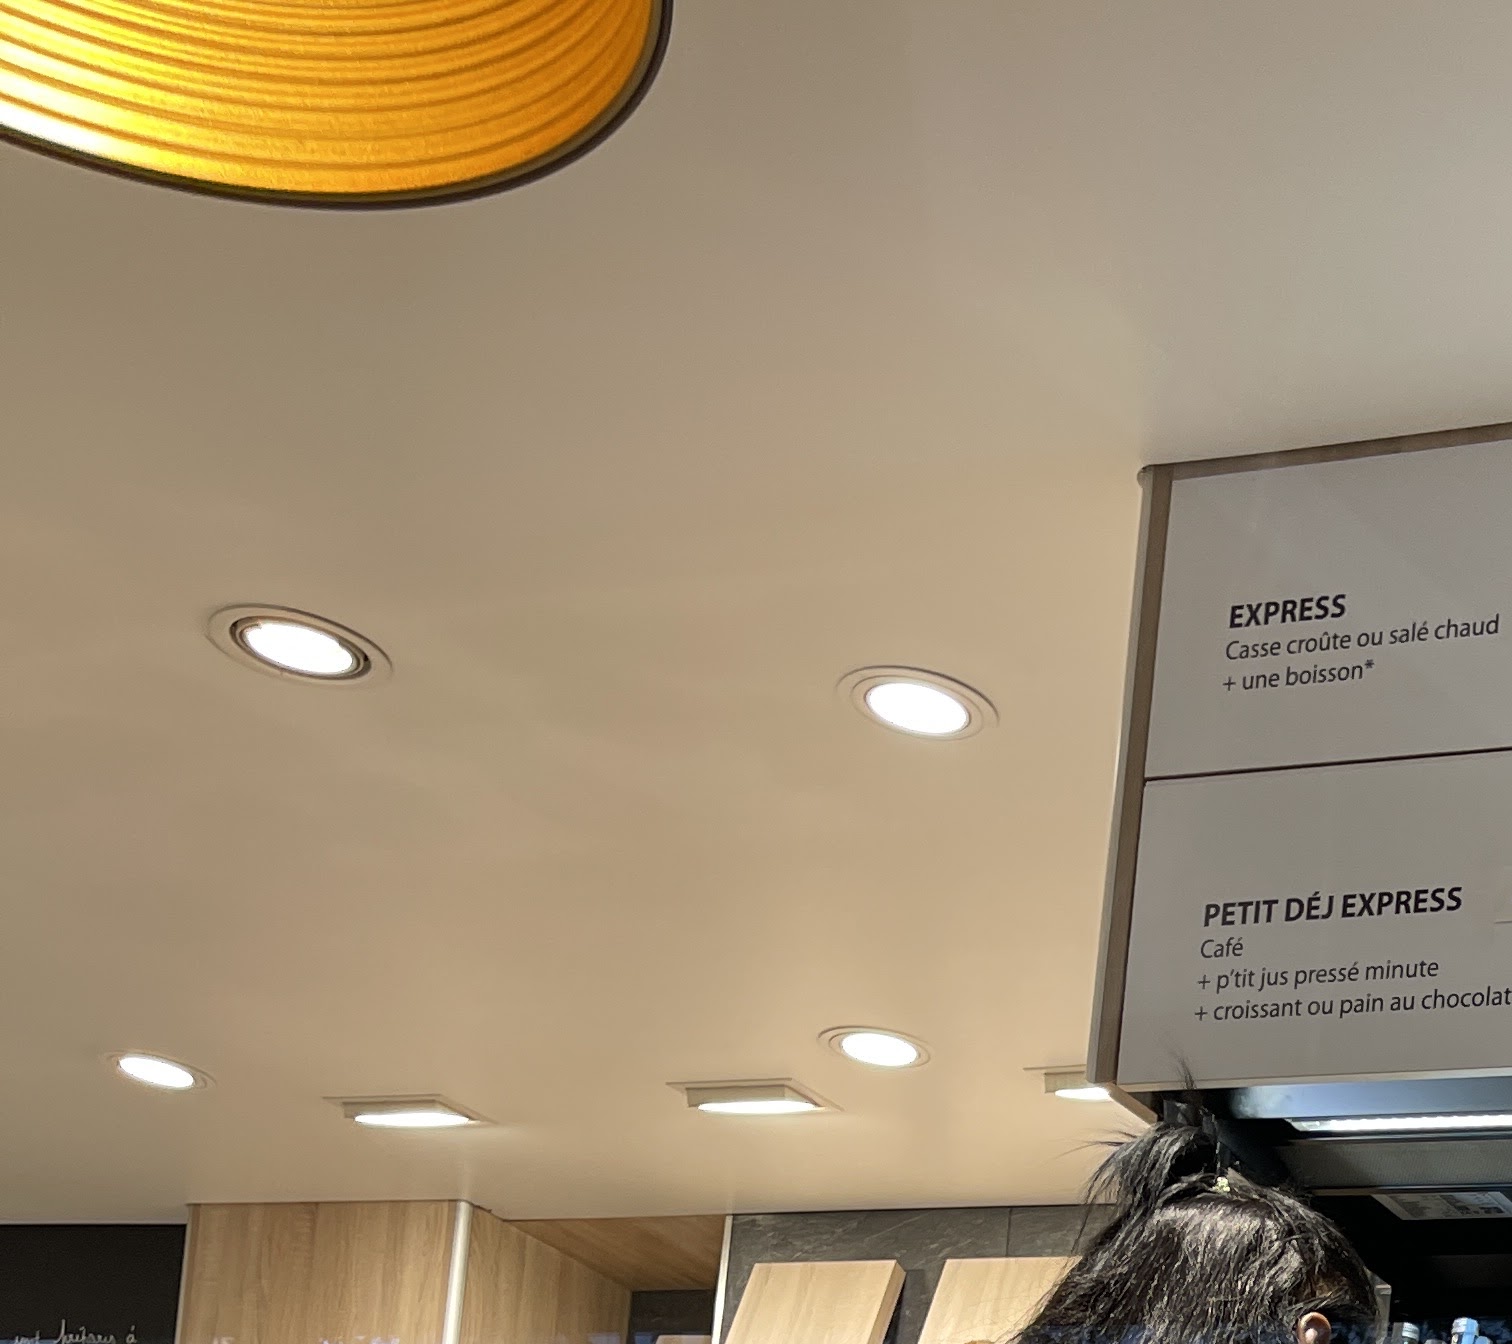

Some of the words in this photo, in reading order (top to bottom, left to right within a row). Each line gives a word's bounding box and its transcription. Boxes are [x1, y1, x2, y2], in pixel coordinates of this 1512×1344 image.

[1229, 594, 1346, 628] EXPRESS
[1226, 641, 1281, 660] Casse
[1287, 632, 1351, 654] croûte
[1357, 631, 1383, 647] ou
[1389, 621, 1428, 644] salé
[1434, 613, 1499, 639] chaud
[1243, 673, 1280, 690] une
[1204, 899, 1279, 927] PETIT
[1285, 891, 1334, 922] DÉJ
[1341, 887, 1462, 918] EXPRESS
[1201, 937, 1243, 958] Café
[1217, 969, 1255, 994] p'tit
[1258, 967, 1288, 992] jus
[1294, 962, 1359, 989] pressé
[1366, 960, 1438, 980] minute
[1214, 1000, 1302, 1020] croissant
[1308, 1000, 1333, 1015] ou
[1340, 993, 1383, 1018] pain
[1390, 996, 1415, 1011] au
[1422, 986, 1512, 1009] chocolat
